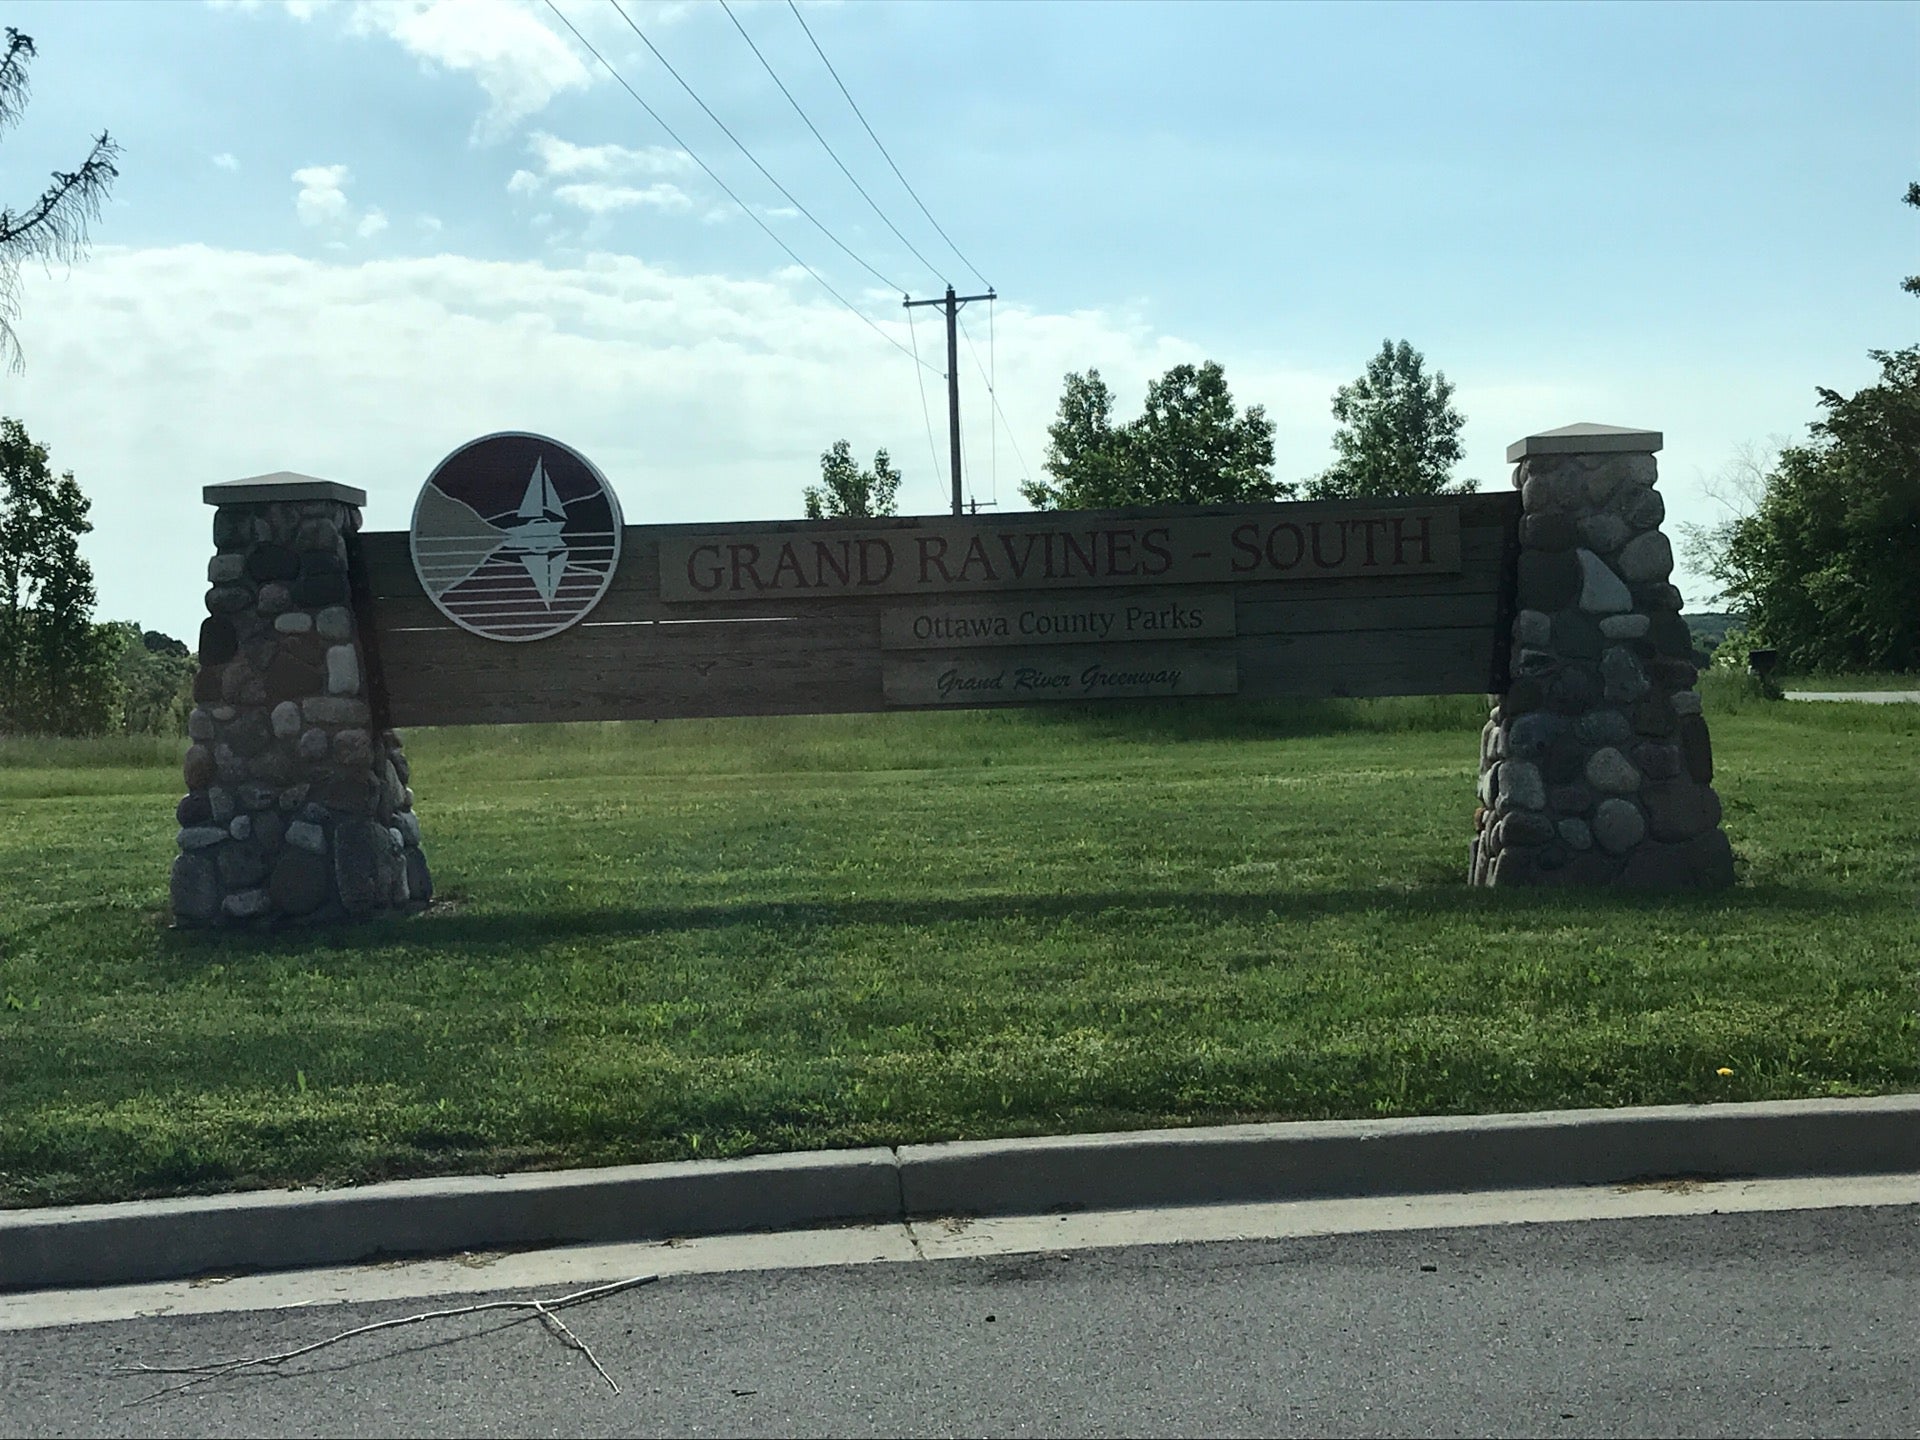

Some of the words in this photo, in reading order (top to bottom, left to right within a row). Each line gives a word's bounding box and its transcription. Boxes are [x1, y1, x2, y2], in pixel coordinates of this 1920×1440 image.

[686, 538, 895, 593] GRAND
[914, 527, 1174, 584] RAVINES
[1192, 551, 1212, 559] -
[1230, 516, 1435, 573] SOUTH
[913, 614, 1010, 639] Ottawa
[1019, 611, 1115, 637] County
[1125, 603, 1204, 631] Parks
[937, 669, 1004, 697] Grand
[1013, 667, 1071, 690] River
[1080, 664, 1182, 693] Greenway
